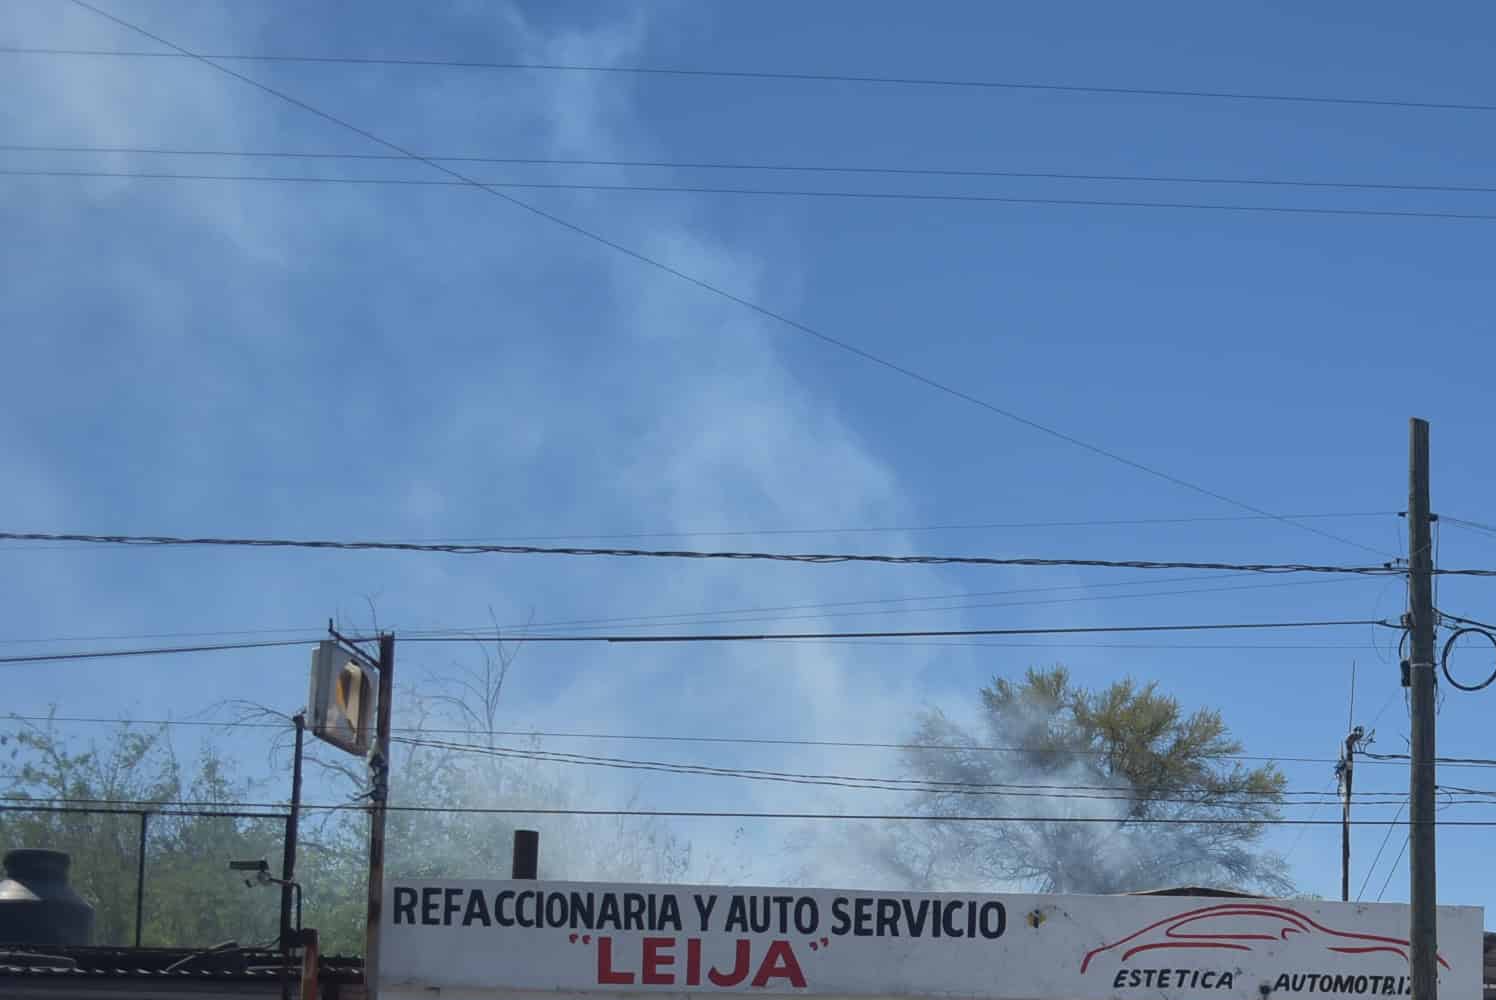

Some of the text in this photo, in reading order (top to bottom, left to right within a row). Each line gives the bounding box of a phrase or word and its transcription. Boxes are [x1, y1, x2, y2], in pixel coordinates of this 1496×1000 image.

[393, 887, 1006, 939] REFACCIONARIA Y AUTO SERVICIO
[569, 935, 829, 988] "LEIJA"
[1113, 969, 1232, 989] ESTETICA
